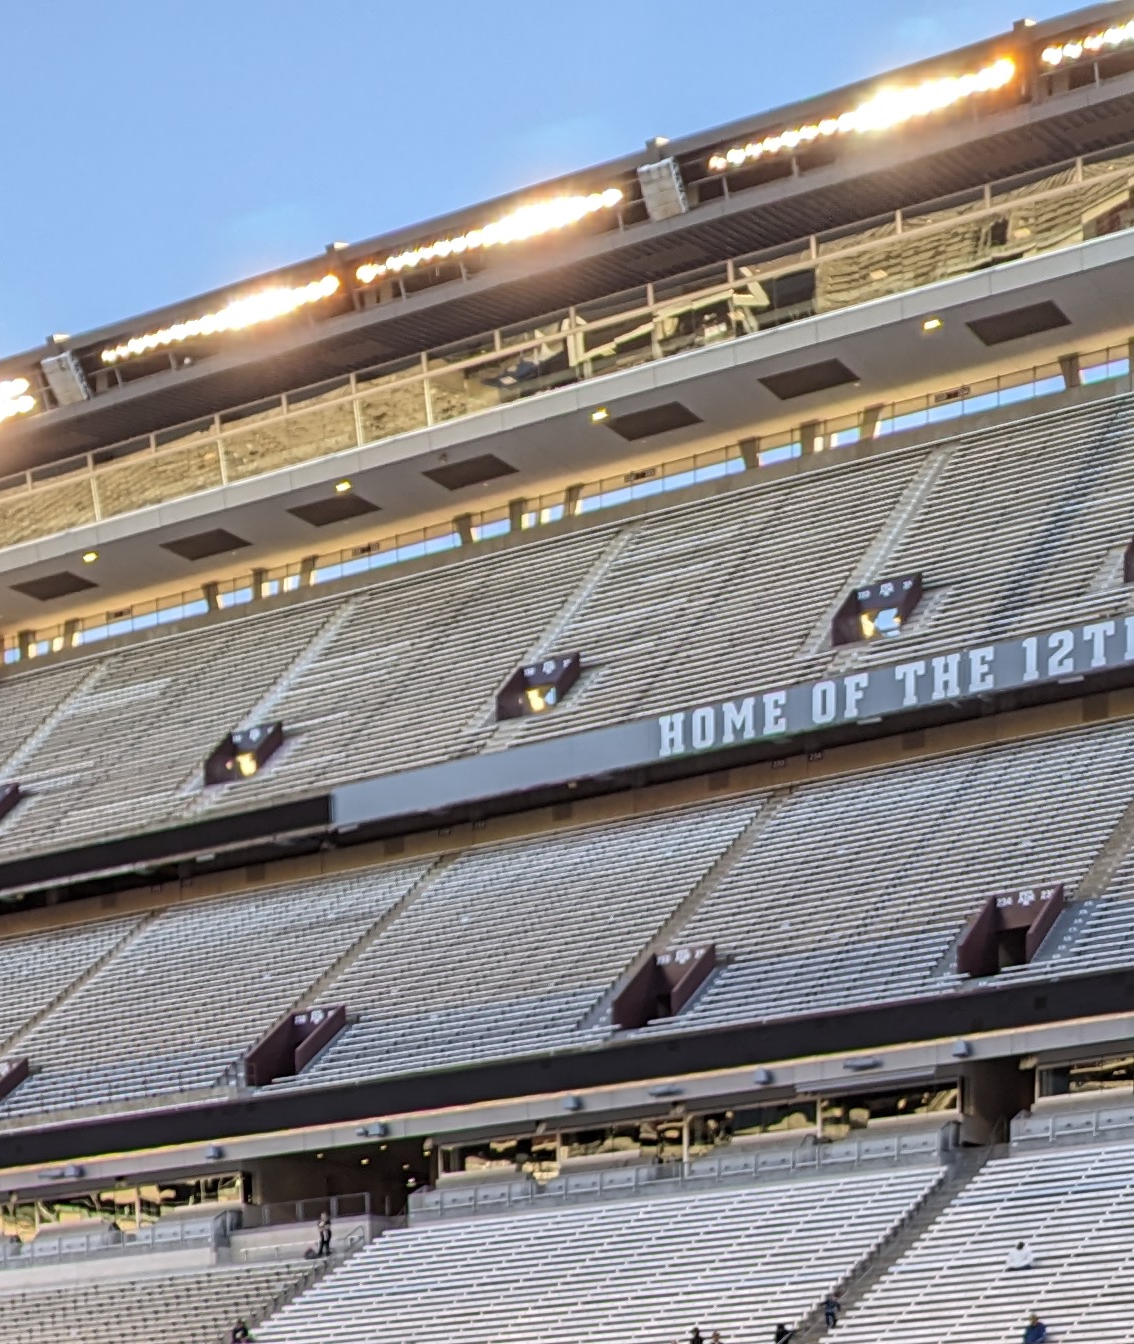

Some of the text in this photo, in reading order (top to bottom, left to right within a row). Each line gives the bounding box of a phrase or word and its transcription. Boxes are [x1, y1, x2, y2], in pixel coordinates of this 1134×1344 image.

[658, 690, 787, 757] HOME
[812, 672, 869, 724] OF
[895, 645, 995, 706] THE
